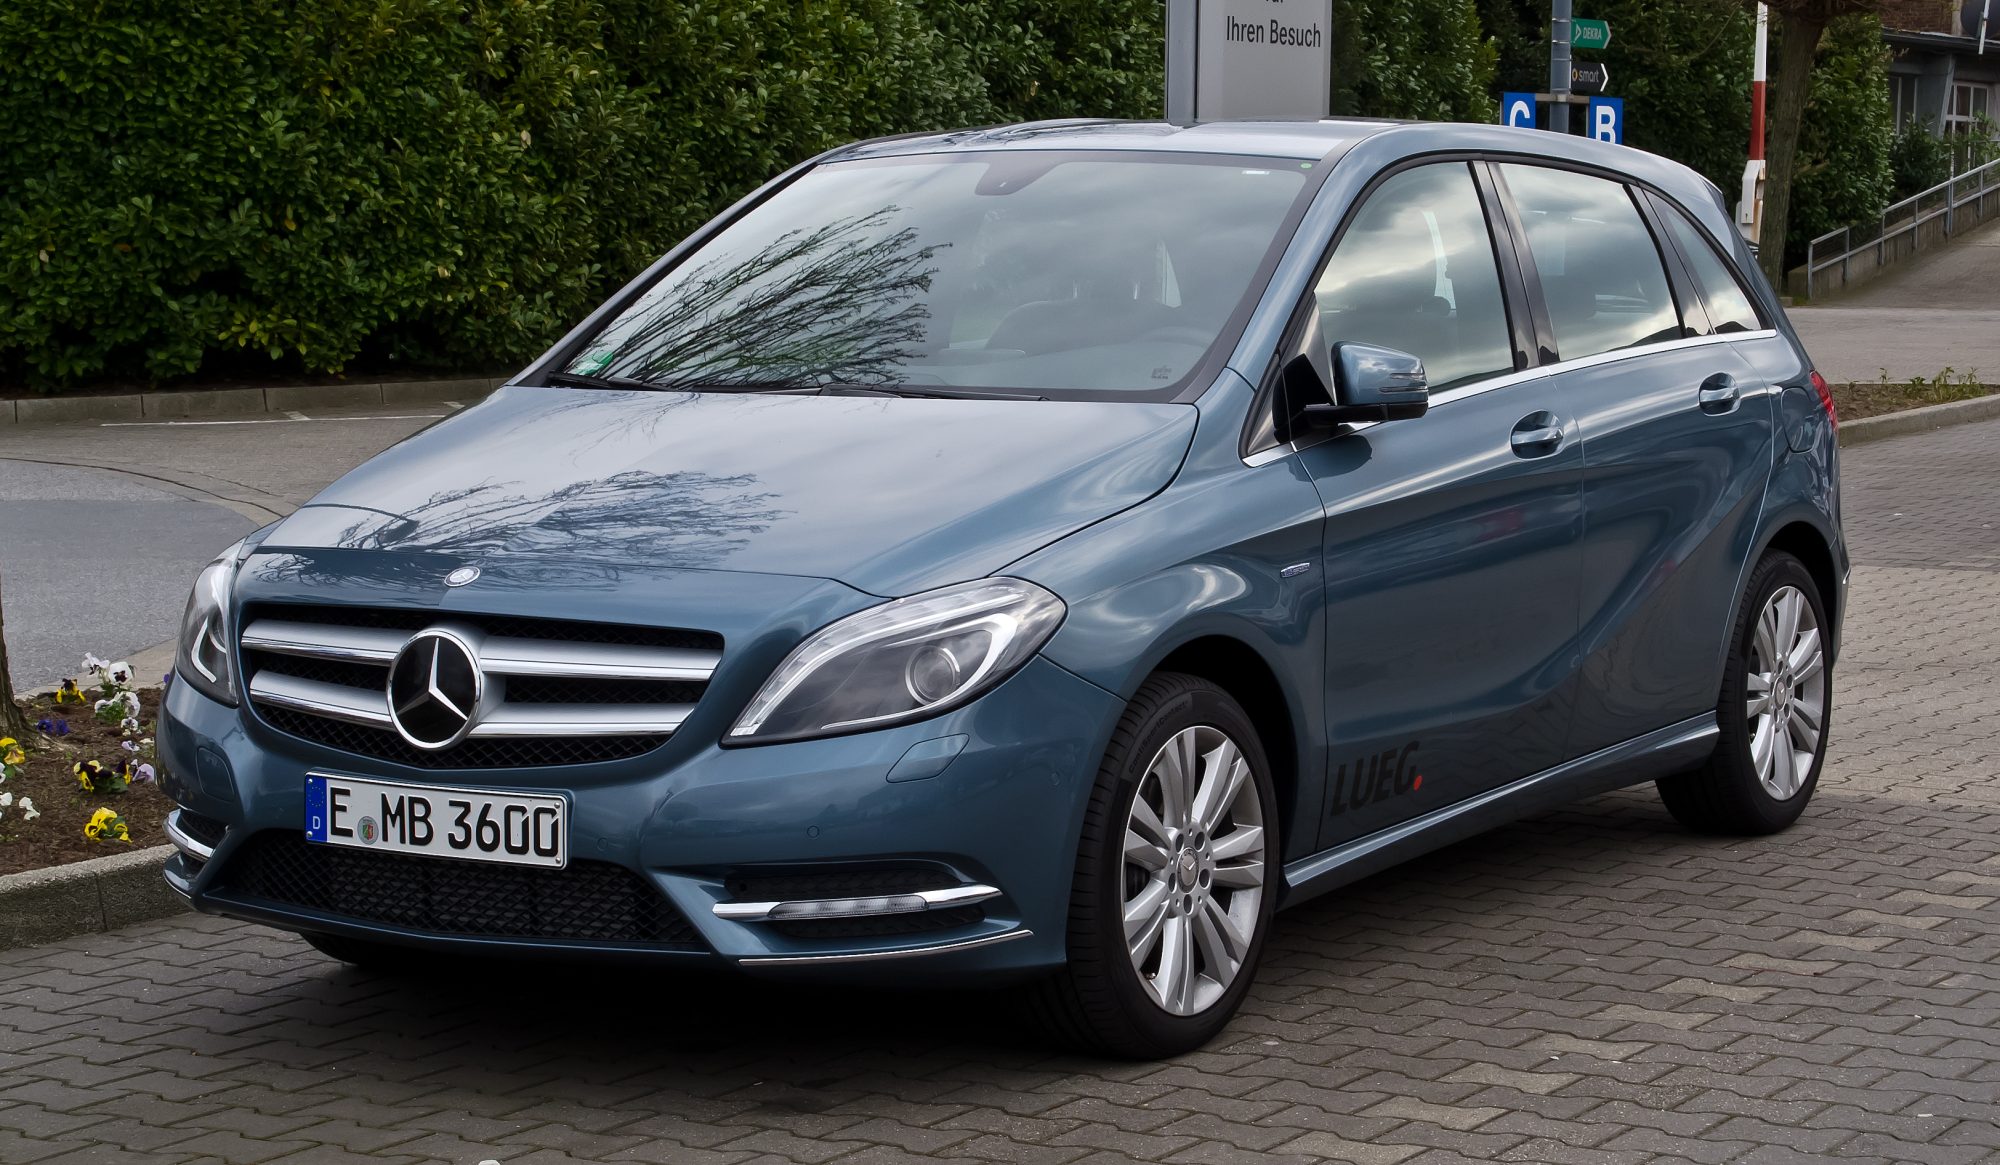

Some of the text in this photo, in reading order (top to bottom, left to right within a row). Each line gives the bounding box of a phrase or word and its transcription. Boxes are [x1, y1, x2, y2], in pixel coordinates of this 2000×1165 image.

[1226, 15, 1321, 48] Ihren Besuch
[1582, 27, 1602, 40] DEKRA
[1579, 69, 1600, 83] smart
[1595, 105, 1616, 144] B
[312, 815, 321, 830] D
[330, 786, 560, 857] E MB 3600
